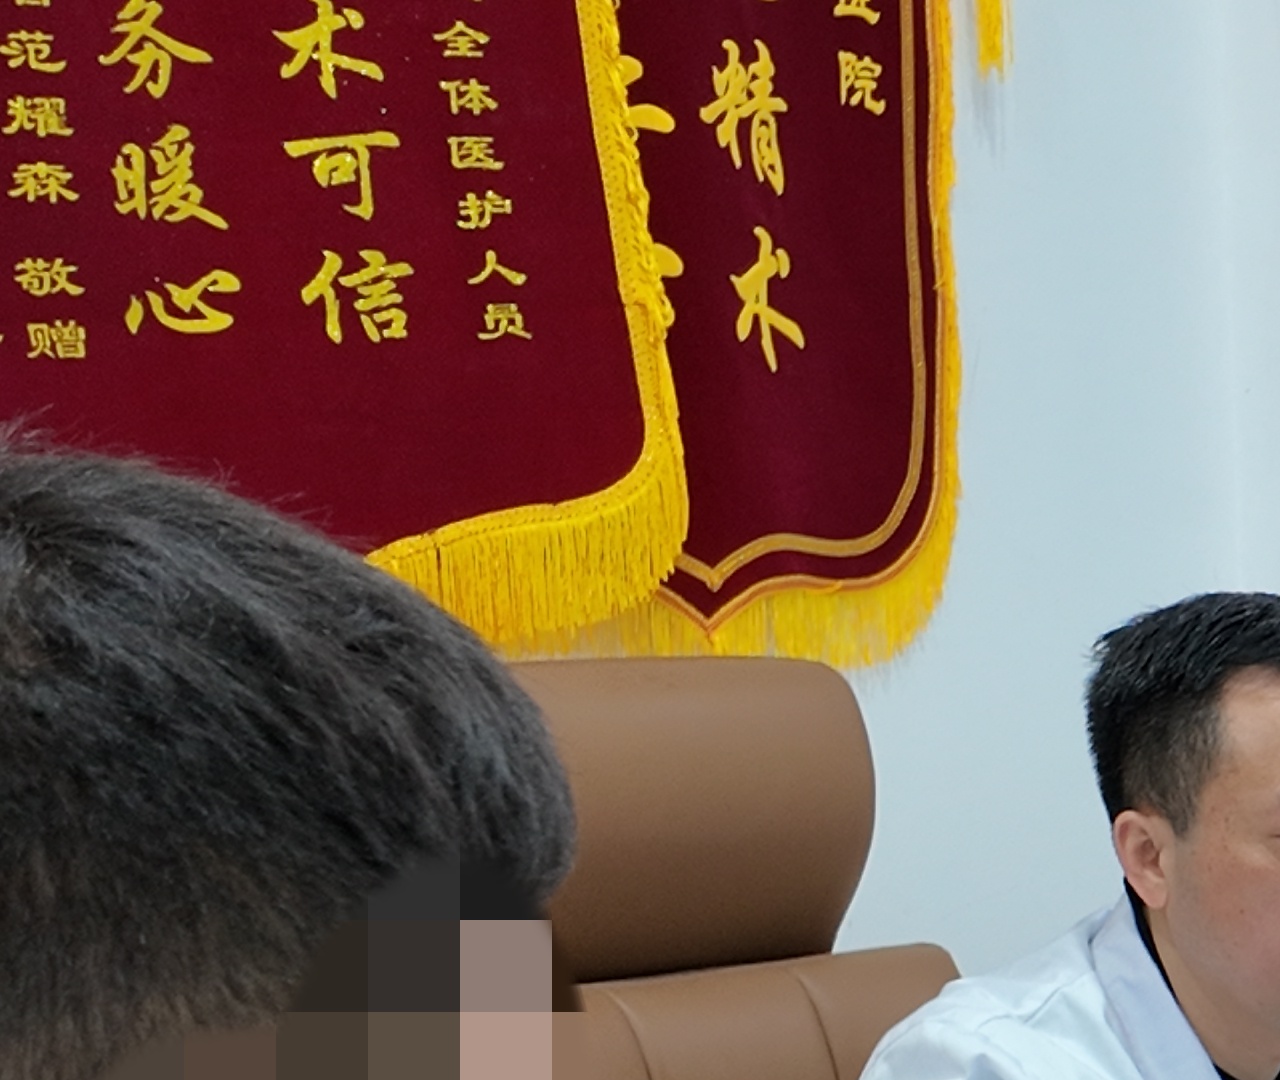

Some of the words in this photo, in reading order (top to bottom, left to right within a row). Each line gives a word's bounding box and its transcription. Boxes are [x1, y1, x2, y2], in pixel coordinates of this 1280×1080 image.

[0, 0, 84, 203] 范耀森
[98, 0, 243, 335] 务暖心
[273, 0, 414, 345] 术可信
[433, 19, 532, 341] 全体医护人员
[698, 37, 806, 372] 精术
[14, 257, 88, 360] 敬赠
